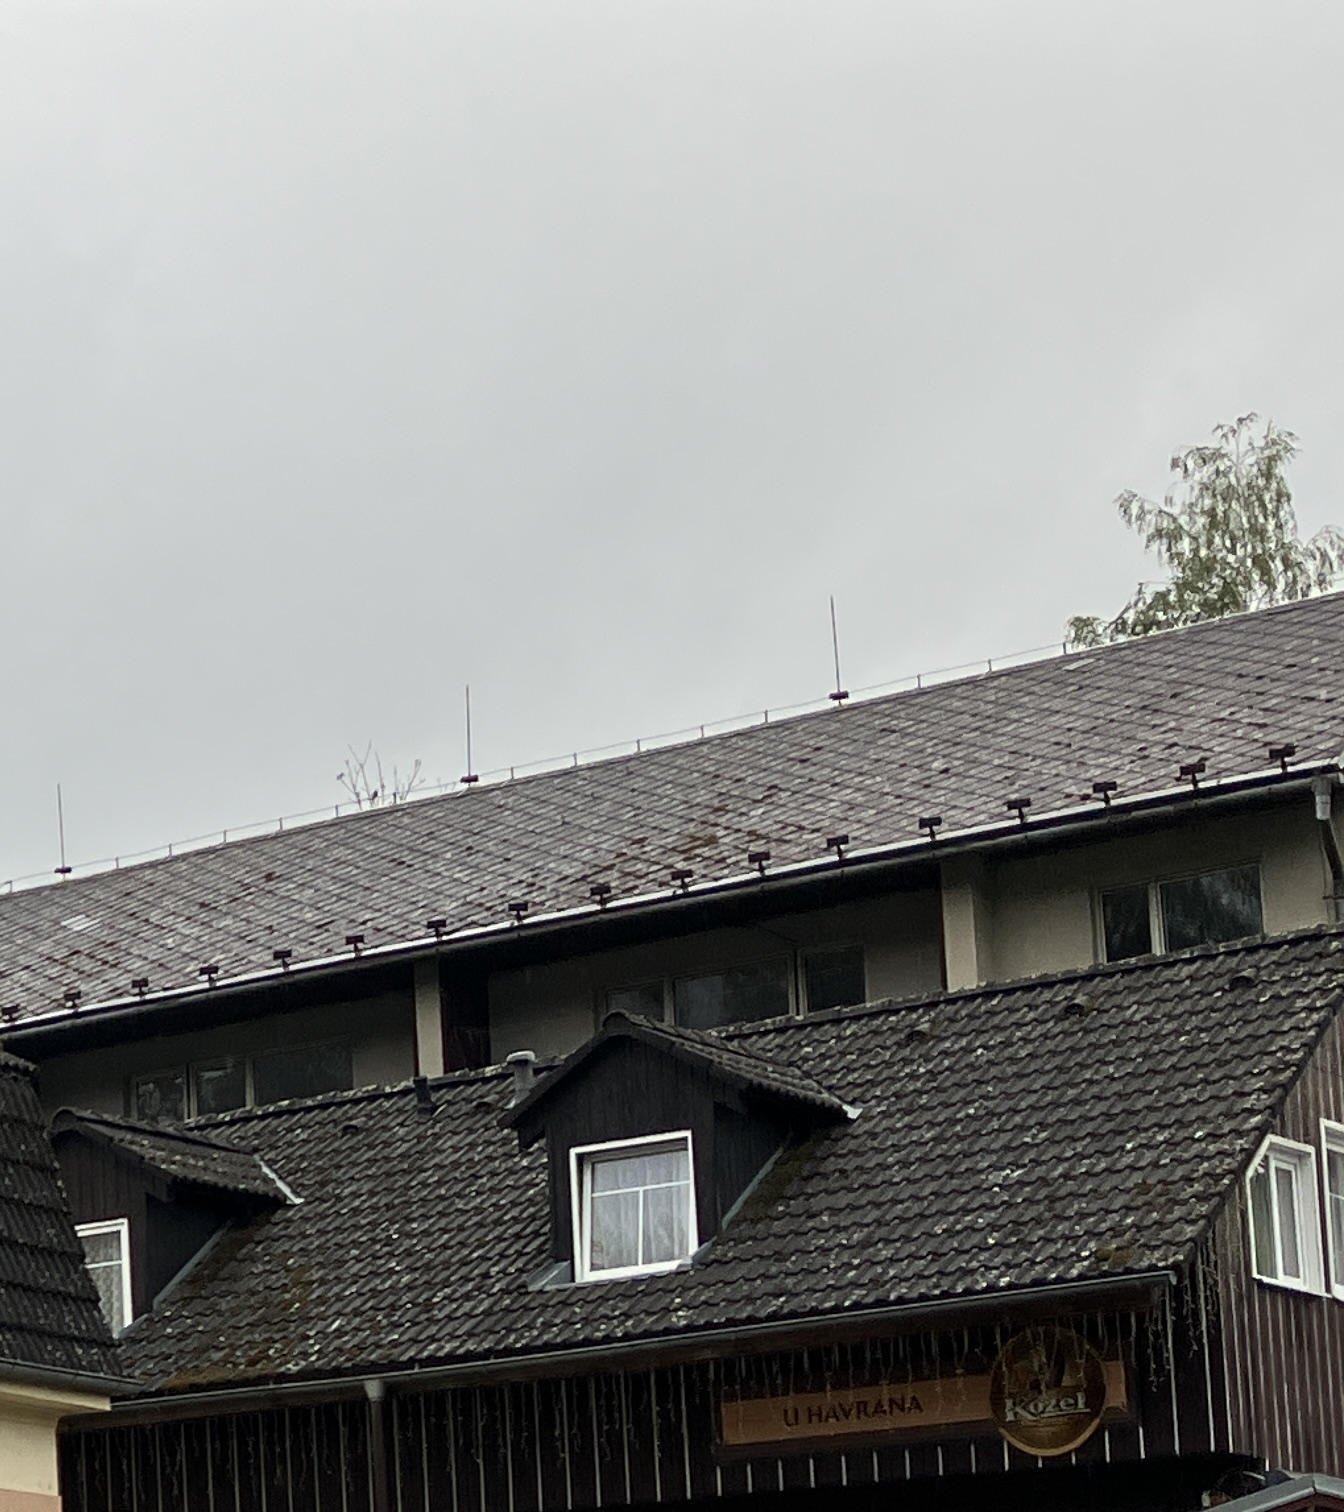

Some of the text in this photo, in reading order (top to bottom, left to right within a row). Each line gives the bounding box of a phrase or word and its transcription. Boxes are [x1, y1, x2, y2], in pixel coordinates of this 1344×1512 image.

[783, 1395, 924, 1427] U HAVRANA
[1004, 1391, 1087, 1421] Kozel
